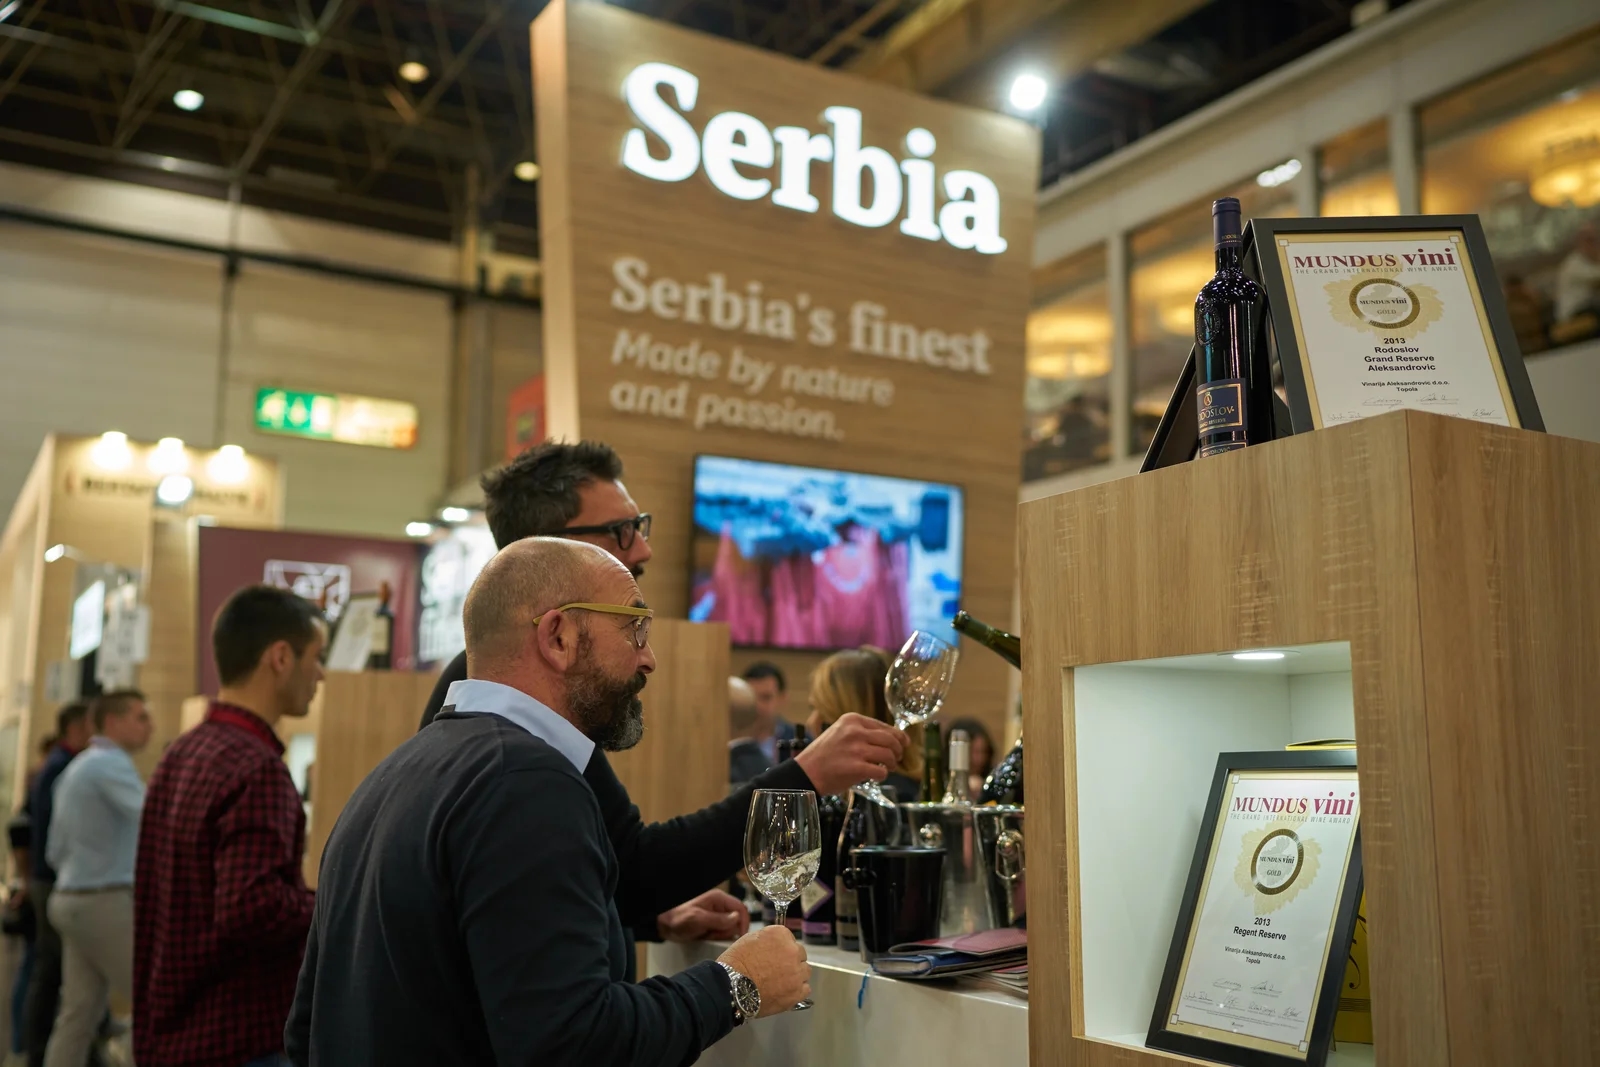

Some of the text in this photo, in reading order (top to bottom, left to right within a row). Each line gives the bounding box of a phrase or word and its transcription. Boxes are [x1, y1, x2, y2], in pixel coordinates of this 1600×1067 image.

[622, 61, 1008, 255] Serbia
[1293, 247, 1456, 269] MUNDUS vini
[1343, 267, 1404, 275] INTERNATIONAL
[610, 256, 993, 374] Serbia's finest
[1383, 337, 1406, 345] 2013
[1374, 346, 1420, 354] Rodoslov
[1364, 354, 1435, 363] Grand Reserve
[610, 329, 896, 407] Made by nature
[1368, 363, 1436, 372] Aleksandrovic
[609, 379, 846, 441] and passion.
[1232, 791, 1356, 816] MUNDUS vini
[1263, 815, 1308, 823] INTERNATIONAL
[1282, 855, 1295, 864] vini
[1266, 869, 1282, 877] GOLD
[1254, 917, 1271, 927] 2013
[1233, 926, 1287, 941] Regent Reserve
[1224, 946, 1287, 961] Vinarija Aleksandrovic d.o.o.
[1245, 957, 1261, 965] Topola
